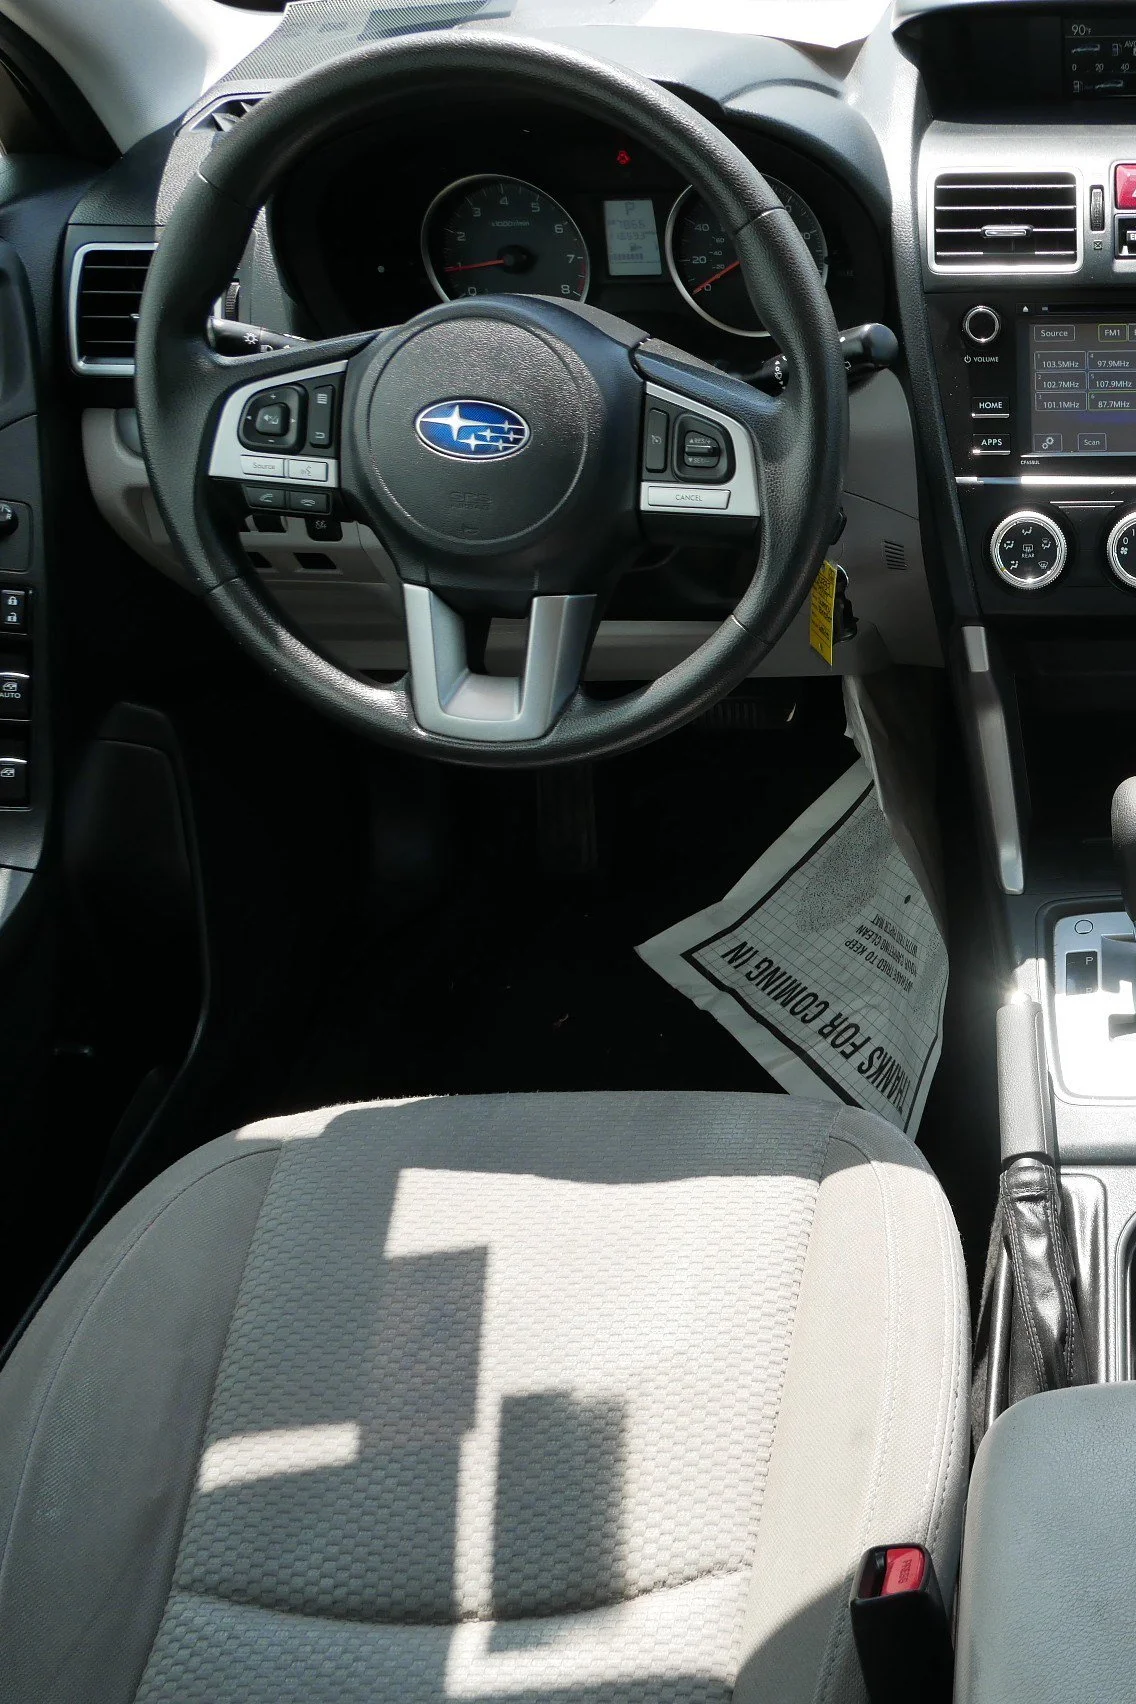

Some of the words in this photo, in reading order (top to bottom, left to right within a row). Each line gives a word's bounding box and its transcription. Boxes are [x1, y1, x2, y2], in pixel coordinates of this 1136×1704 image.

[1095, 63, 1104, 72] 20
[1120, 63, 1130, 71] 40
[499, 196, 509, 205] 4
[473, 207, 482, 217] 3
[531, 203, 540, 213] 5
[554, 224, 564, 234] 6
[694, 223, 710, 232] 40
[457, 231, 466, 242] 2
[566, 254, 575, 264] 7
[692, 256, 707, 264] 20
[560, 284, 570, 294] 8
[1040, 329, 1069, 337] Source
[1104, 329, 1121, 337] FM1
[1042, 360, 1079, 368] 103.5MHz
[1097, 360, 1130, 368] 97.9MHz
[1095, 380, 1132, 388] 107.9MHz
[978, 401, 1003, 409] HOME
[1043, 401, 1080, 409] 101.1MHz
[981, 438, 1003, 446] APPS
[1084, 438, 1100, 446] Scan
[253, 462, 276, 470] Source
[675, 494, 703, 502] CANCEL
[1122, 537, 1129, 545] 0
[856, 925, 882, 947] CLEAN
[844, 938, 868, 956] KEEP
[720, 940, 759, 968] IN
[865, 951, 879, 965] TO
[1085, 956, 1093, 965] P
[876, 958, 894, 978] TRIED
[745, 956, 830, 1024] COMING
[818, 1012, 872, 1060] FOR
[857, 1046, 911, 1114] THANKS
